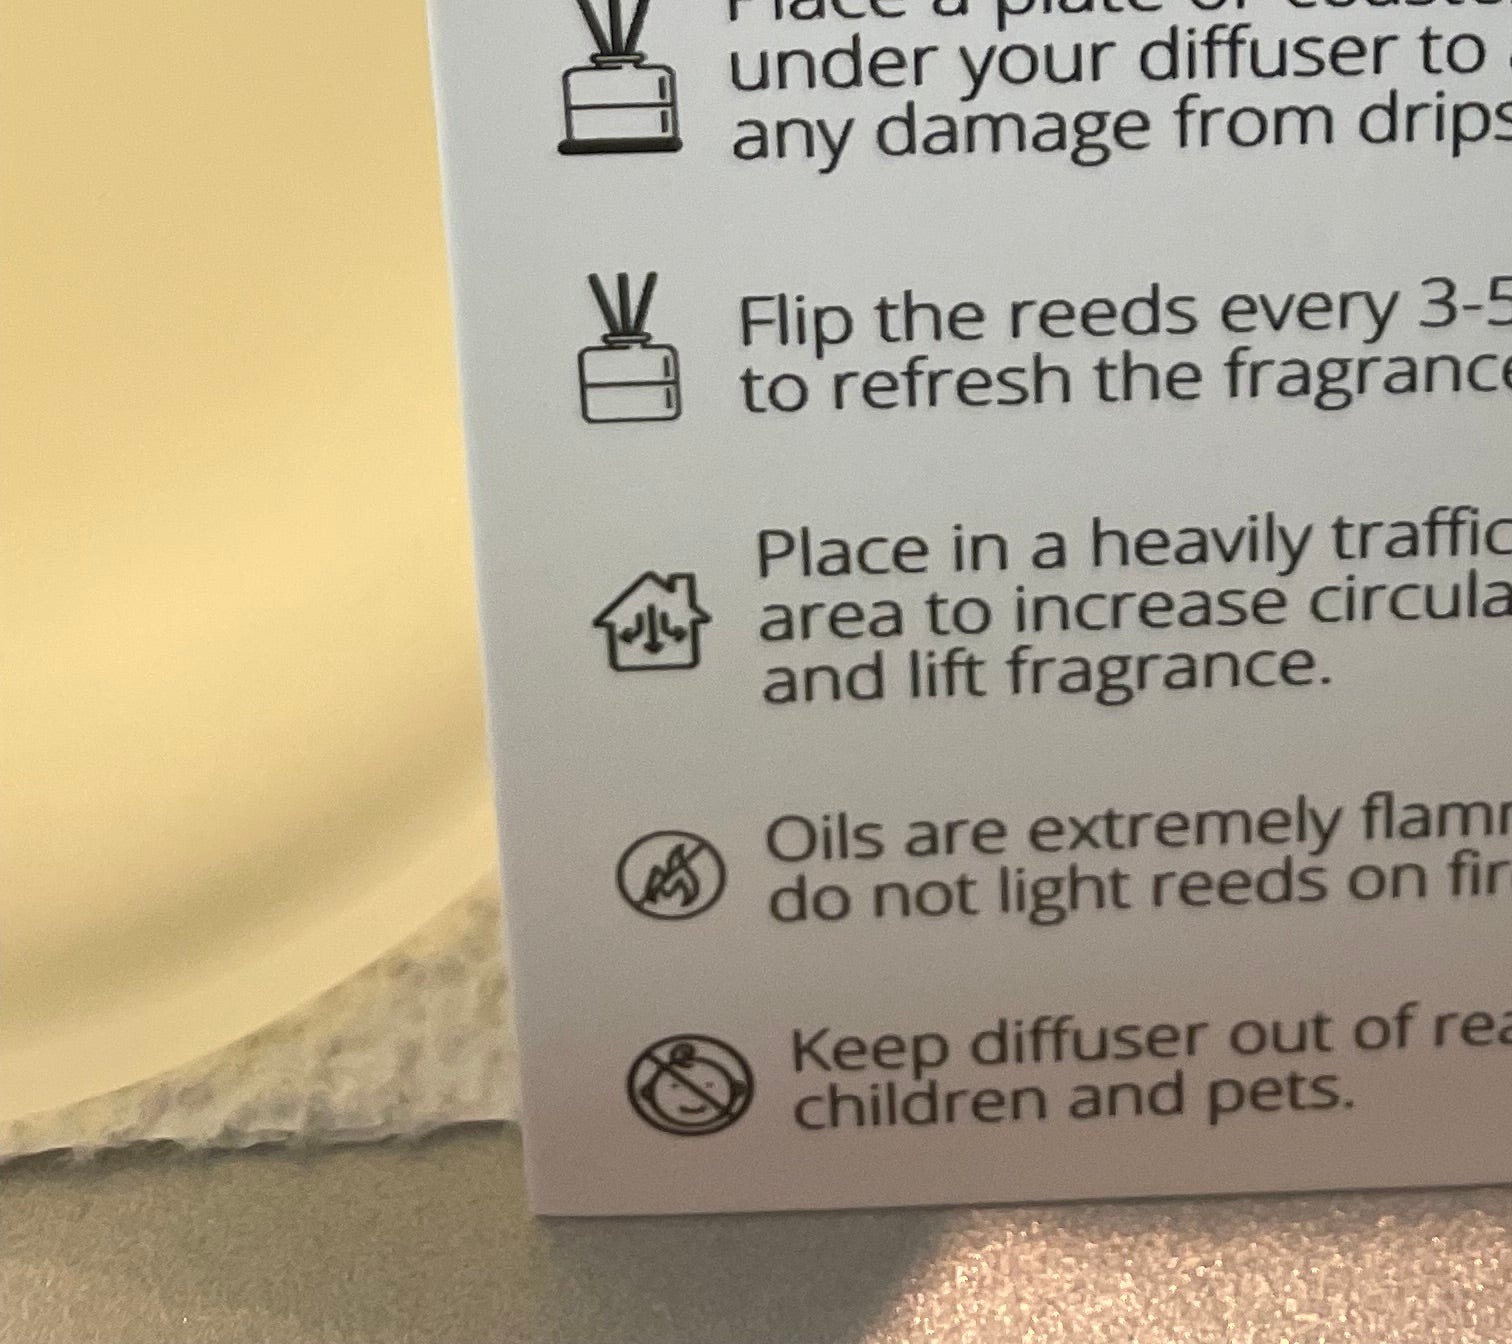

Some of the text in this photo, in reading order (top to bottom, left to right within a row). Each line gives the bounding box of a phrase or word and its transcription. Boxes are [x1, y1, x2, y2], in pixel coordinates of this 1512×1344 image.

[731, 32, 939, 92] under
[958, 41, 1116, 102] your
[1140, 22, 1400, 81] diffuser
[1418, 26, 1486, 75] to
[733, 118, 855, 175] any
[876, 100, 1150, 168] damage
[1173, 93, 1334, 148] from
[740, 293, 853, 360] Flip
[873, 289, 986, 343] the
[1011, 282, 1198, 339] reeds
[1221, 291, 1400, 344] every
[739, 368, 808, 413] to
[834, 352, 1071, 410] refresh
[1093, 349, 1202, 403] the
[757, 526, 929, 578] Place
[953, 524, 1008, 572] in
[1032, 532, 1066, 569] a
[1092, 512, 1312, 577] heavily
[760, 600, 903, 642] area
[925, 592, 992, 636] to
[1016, 585, 1287, 632] increase
[763, 645, 1330, 707] and lift fragrance.
[766, 812, 884, 862] Oils
[905, 818, 1007, 858] are
[1029, 794, 1342, 856] extremely
[769, 874, 850, 923] do
[874, 874, 979, 917] not
[1000, 863, 1131, 926] light
[1153, 855, 1327, 907] reeds
[1349, 863, 1426, 900] on
[793, 1029, 949, 1080] Keep
[972, 1015, 1208, 1065] diffuser
[1230, 1014, 1331, 1055] out
[1355, 1002, 1417, 1050] of
[794, 1069, 1353, 1130] children and pets.
